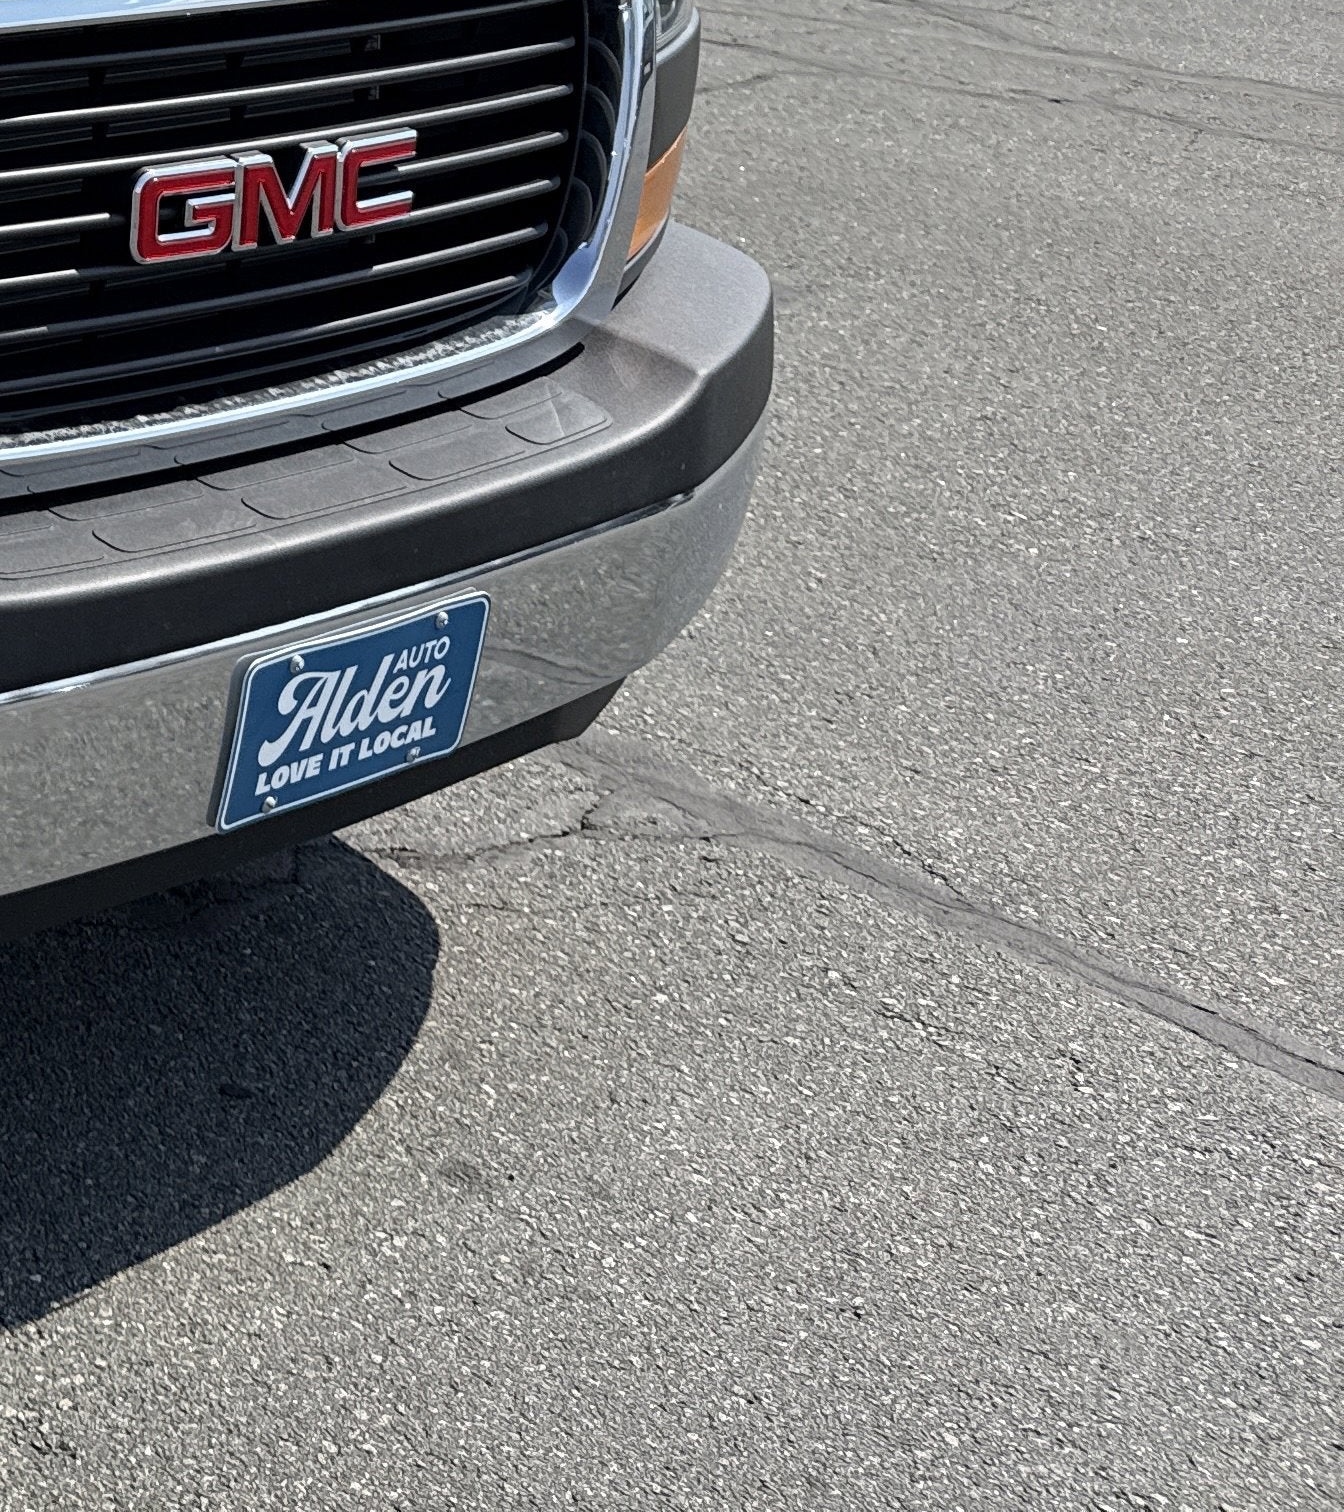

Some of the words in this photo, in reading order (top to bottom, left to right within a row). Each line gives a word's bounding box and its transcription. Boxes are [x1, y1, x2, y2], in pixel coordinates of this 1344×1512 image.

[130, 127, 417, 265] GMC
[393, 636, 451, 674] AUTO
[254, 752, 323, 796] LOVE
[328, 742, 356, 770] IT
[357, 716, 436, 760] LOCAL
[257, 653, 451, 767] Alden
